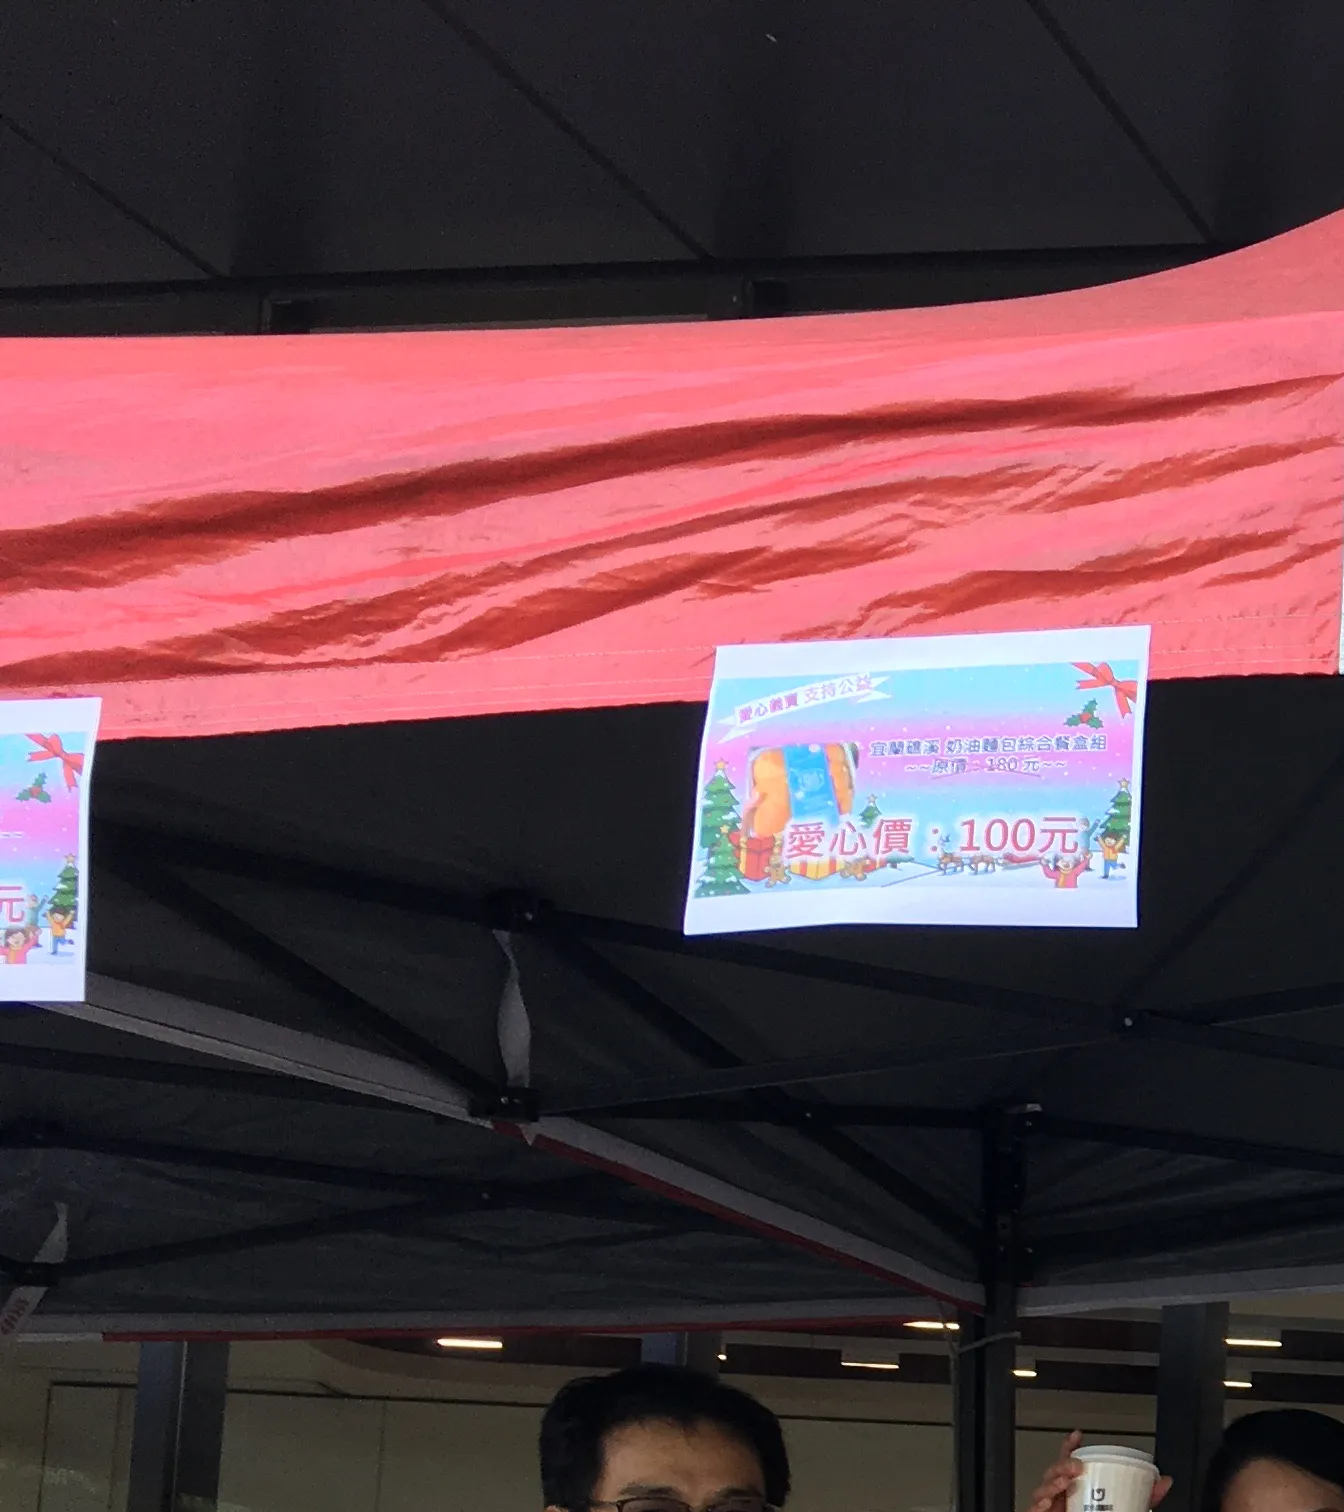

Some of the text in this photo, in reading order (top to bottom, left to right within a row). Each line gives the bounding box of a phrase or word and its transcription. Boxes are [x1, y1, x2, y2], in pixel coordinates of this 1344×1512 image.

[804, 674, 874, 704] 支持公益
[870, 734, 1108, 758] 宜蘭礁溪 奶油麵包綜合餐盒組
